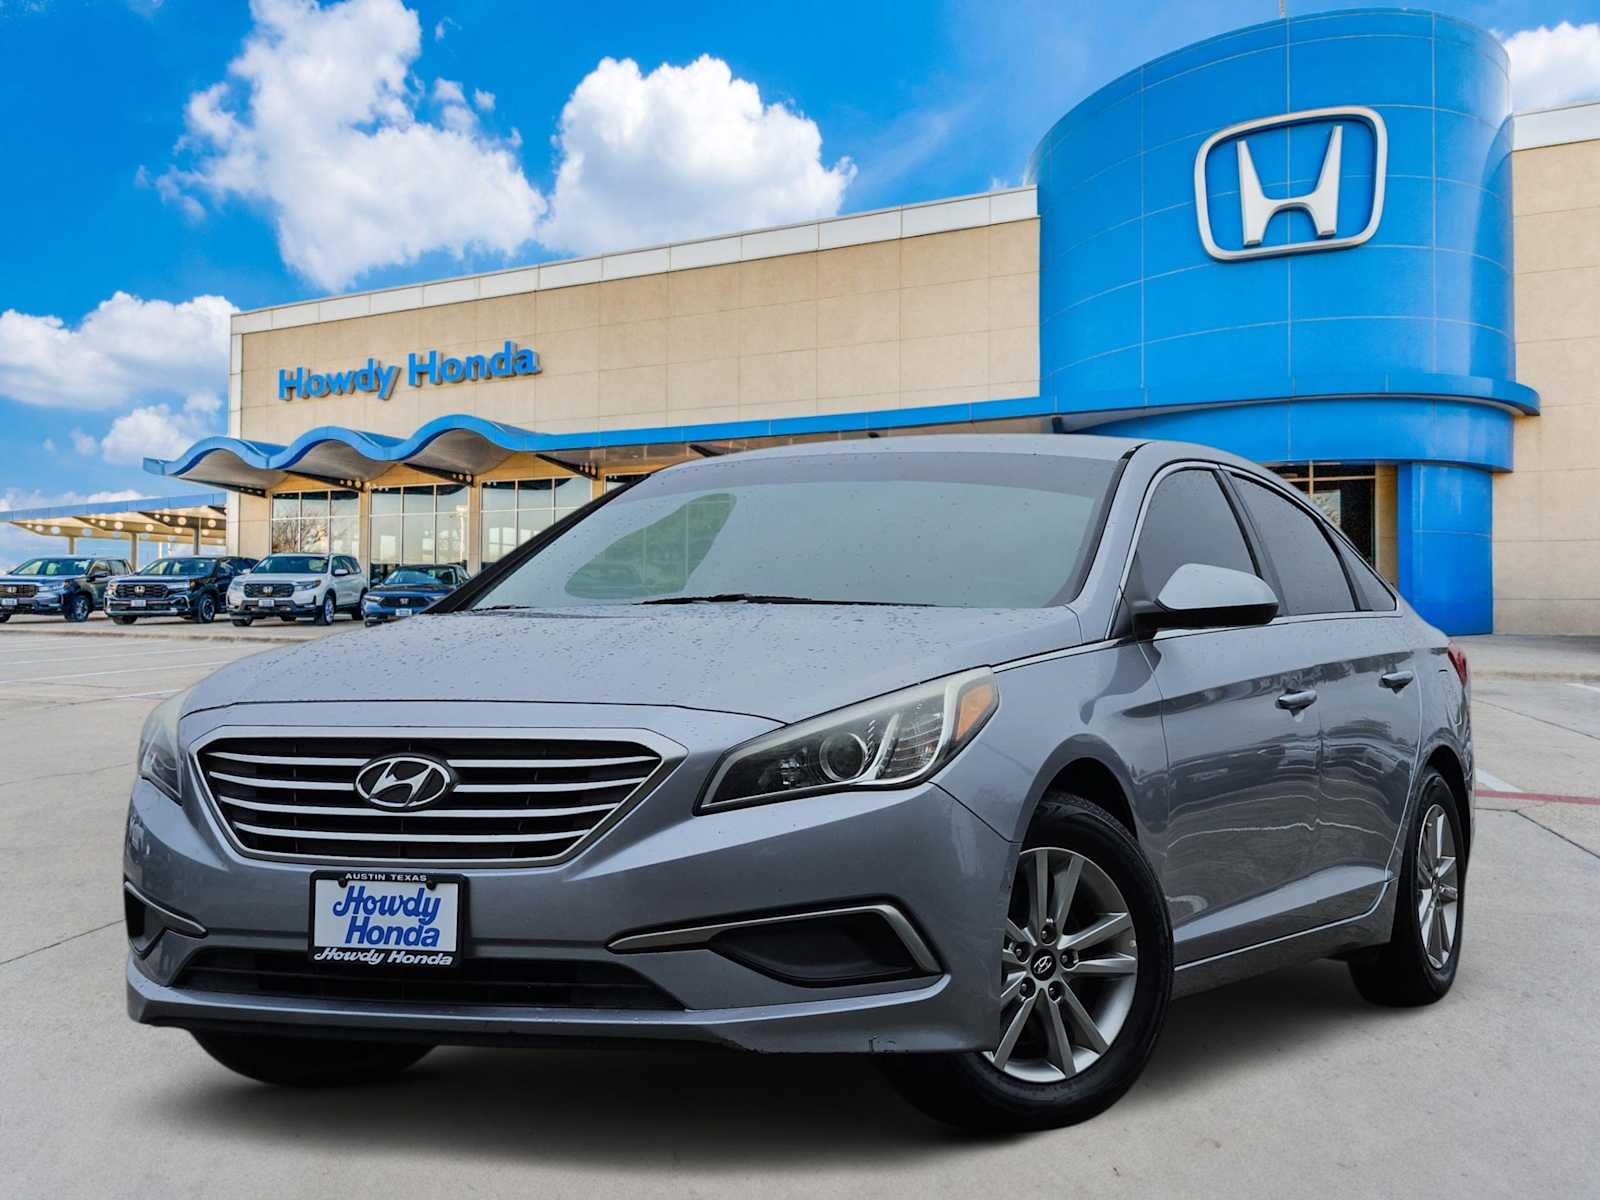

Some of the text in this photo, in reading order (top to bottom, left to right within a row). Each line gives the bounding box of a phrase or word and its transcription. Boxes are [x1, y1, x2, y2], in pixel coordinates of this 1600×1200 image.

[278, 340, 541, 401] Howdy Honda
[345, 873, 427, 882] AUSTIN TEXAS
[332, 885, 441, 925] Howdy
[345, 916, 440, 947] Honda
[314, 948, 453, 966] Howdy Honda
